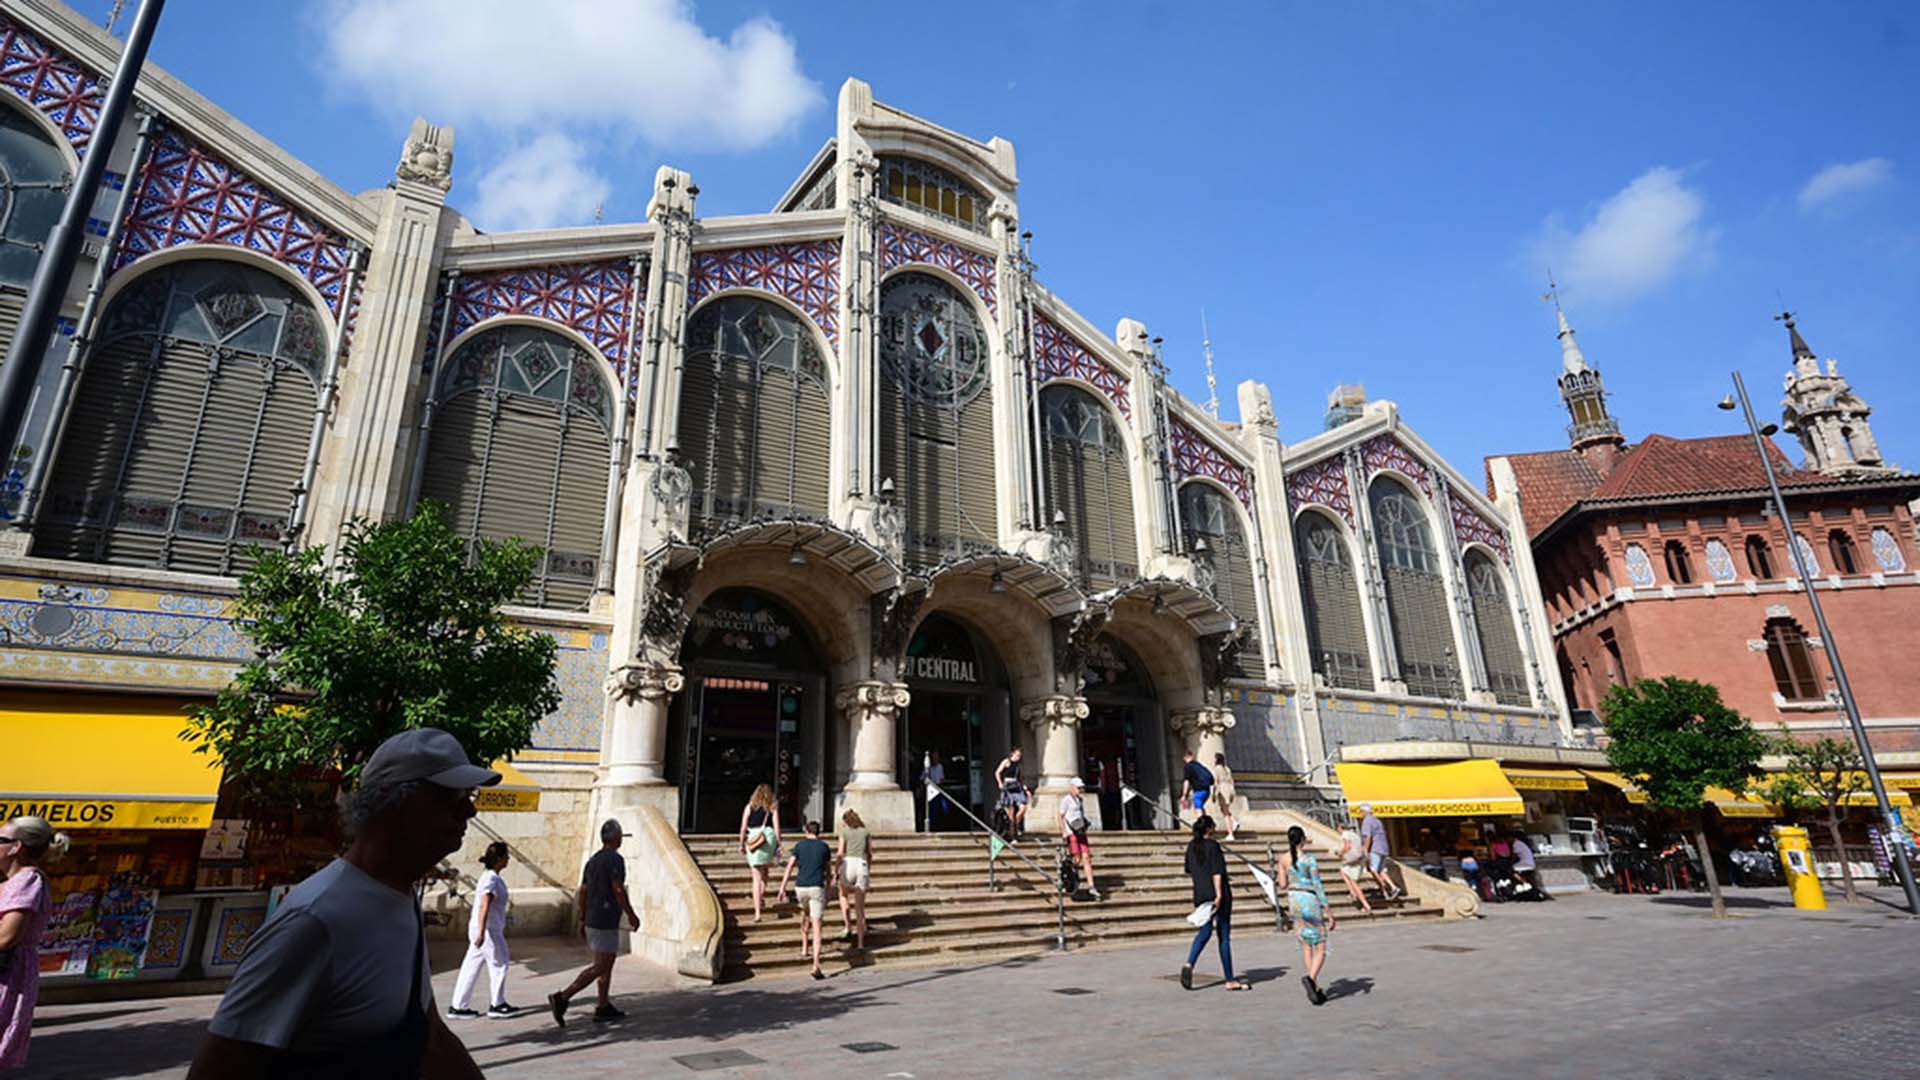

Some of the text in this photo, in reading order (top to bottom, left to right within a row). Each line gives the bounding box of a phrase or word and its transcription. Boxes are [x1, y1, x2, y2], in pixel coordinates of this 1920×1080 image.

[917, 657, 977, 682] CENTRAL
[1396, 803, 1439, 815] CHURROS
[1440, 802, 1492, 813] CHOCOLATE
